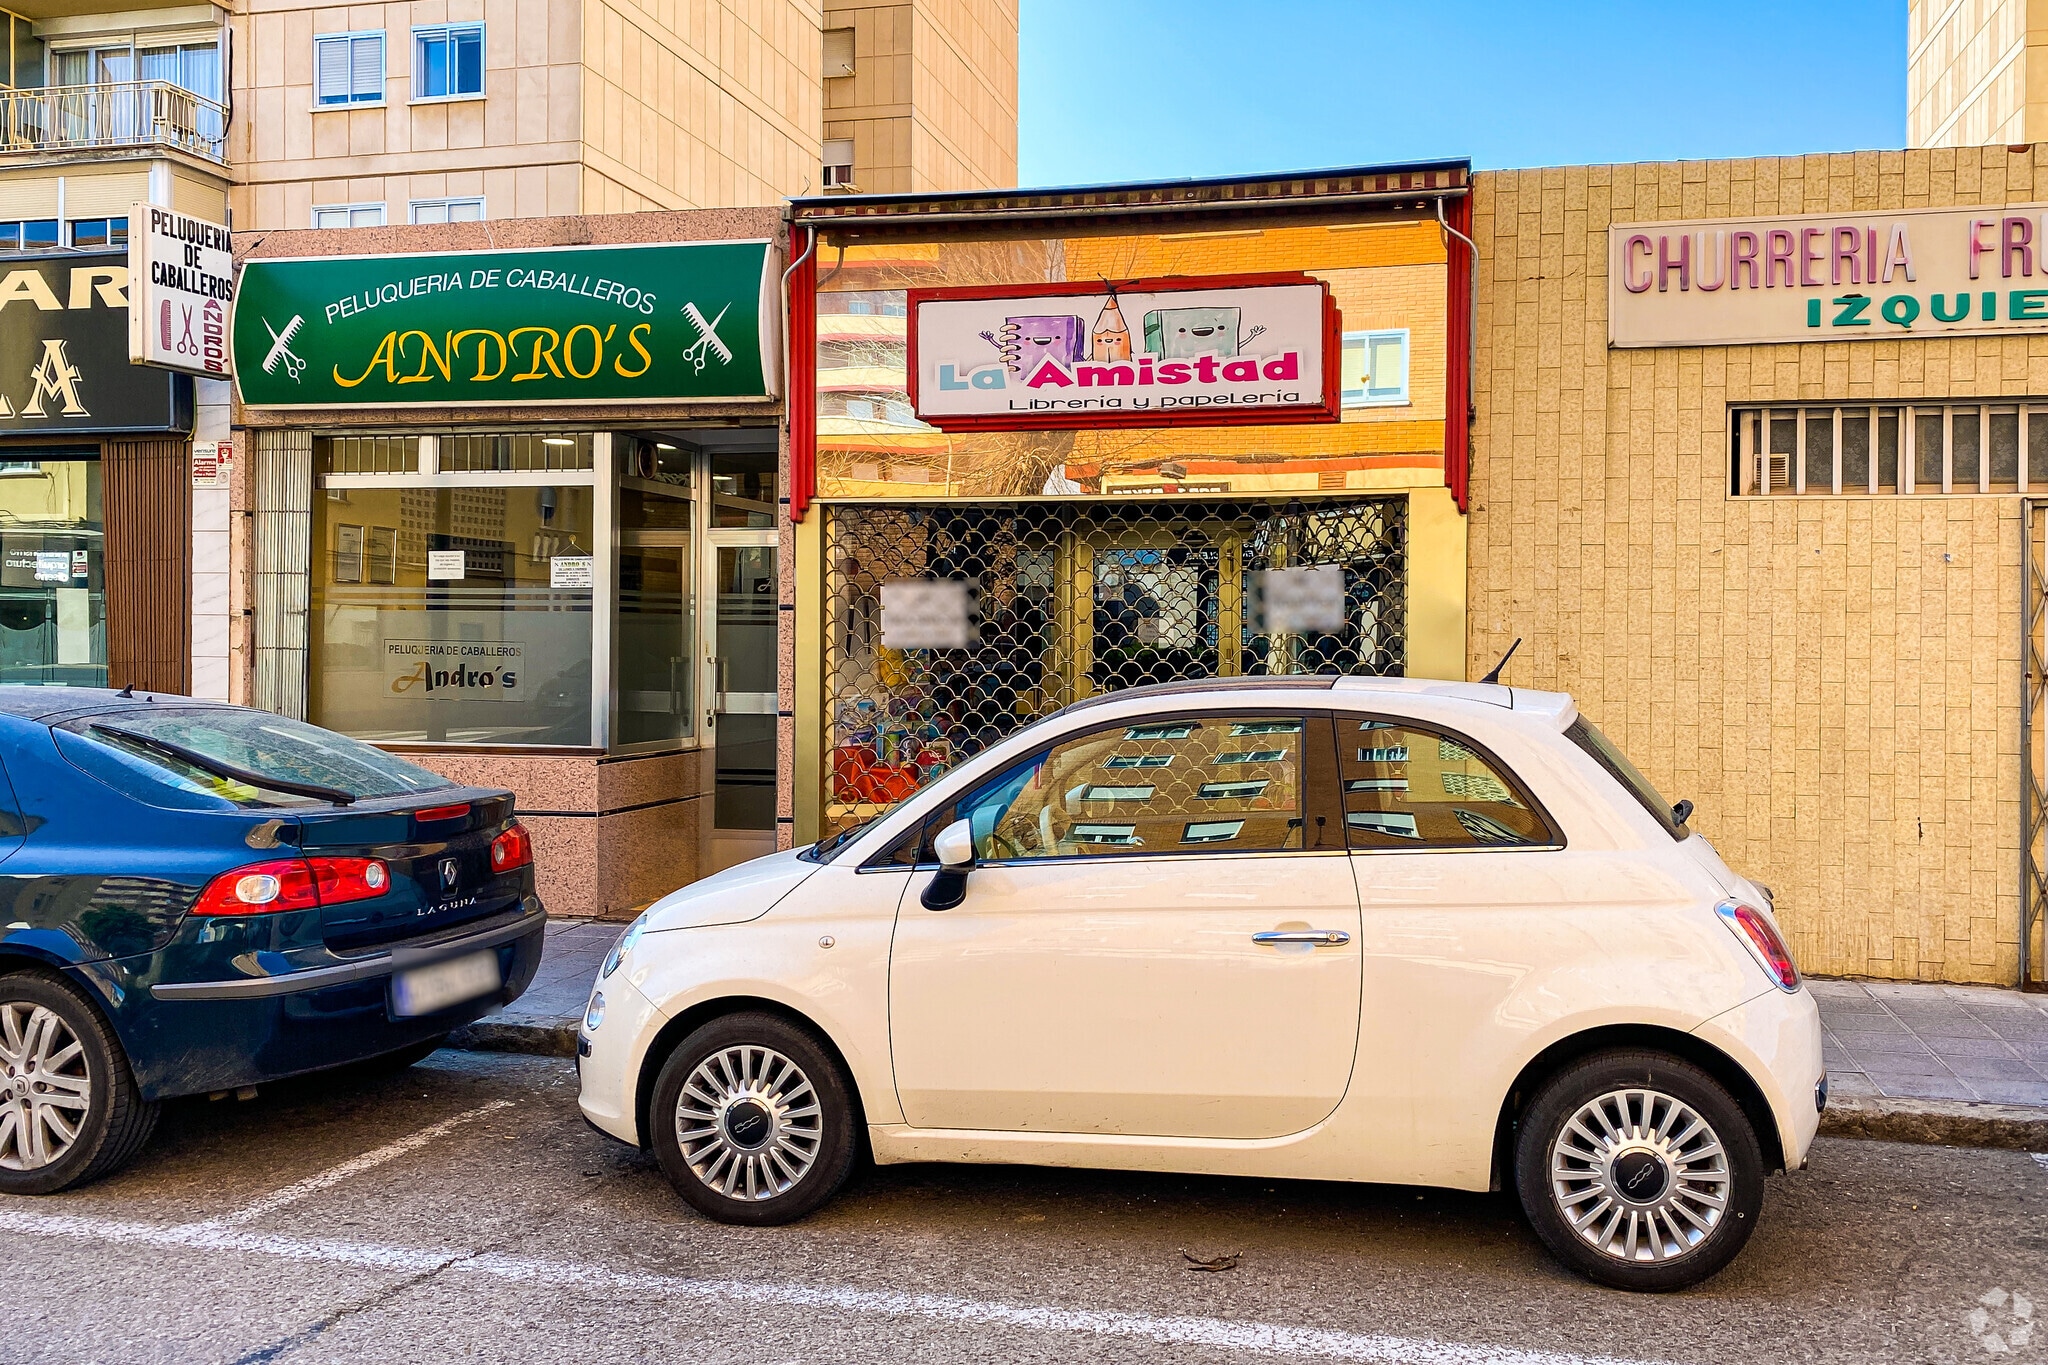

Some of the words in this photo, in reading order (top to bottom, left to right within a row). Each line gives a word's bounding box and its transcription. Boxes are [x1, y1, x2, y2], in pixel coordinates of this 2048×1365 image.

[151, 208, 232, 254] PELUQUERIA
[184, 243, 202, 270] DE
[1623, 223, 1917, 293] CHURRERIA
[151, 260, 233, 302] CABALLEROS
[325, 272, 464, 324] PELUQUERIA
[469, 269, 500, 289] DE
[505, 268, 657, 315] CABALLEROS
[1807, 289, 2048, 328] IZQUIE
[332, 323, 652, 388] ANDRO'S
[940, 365, 1006, 391] La
[1026, 351, 1299, 389] Amistad
[1009, 393, 1122, 411] Librería
[1133, 397, 1150, 410] y
[388, 644, 444, 655] PELUQUERIA
[446, 645, 459, 656] DE
[460, 646, 522, 657] CABALLEROS
[416, 897, 477, 916] LAGUNA
